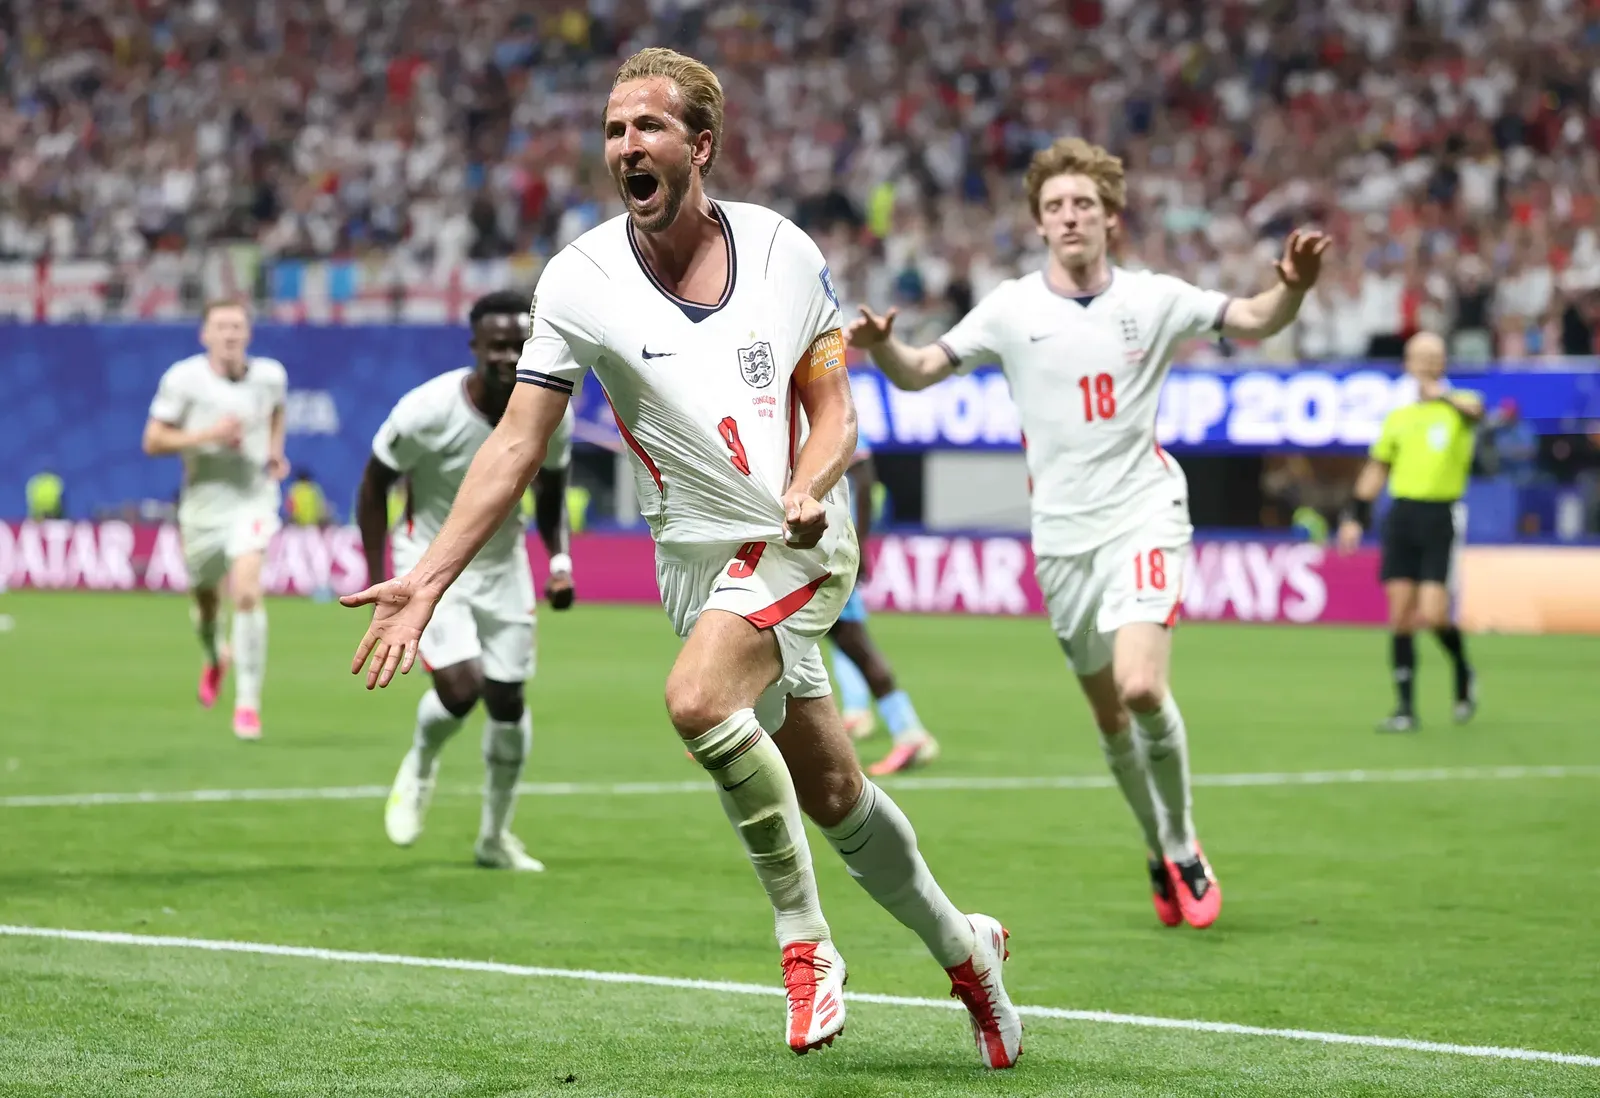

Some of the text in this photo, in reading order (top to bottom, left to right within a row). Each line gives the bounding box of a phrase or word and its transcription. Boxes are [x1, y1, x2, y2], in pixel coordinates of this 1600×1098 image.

[808, 334, 840, 355] UNITES
[810, 355, 825, 367] the
[826, 359, 838, 368] FIFA
[890, 373, 1022, 445] WOR
[1155, 372, 1227, 445] UP
[1227, 371, 1420, 446] 202
[1078, 372, 1117, 423] 18
[717, 416, 751, 476] 9
[727, 541, 767, 578] 9
[862, 535, 1328, 623] ATAR WAYS
[1134, 548, 1166, 590] 18
